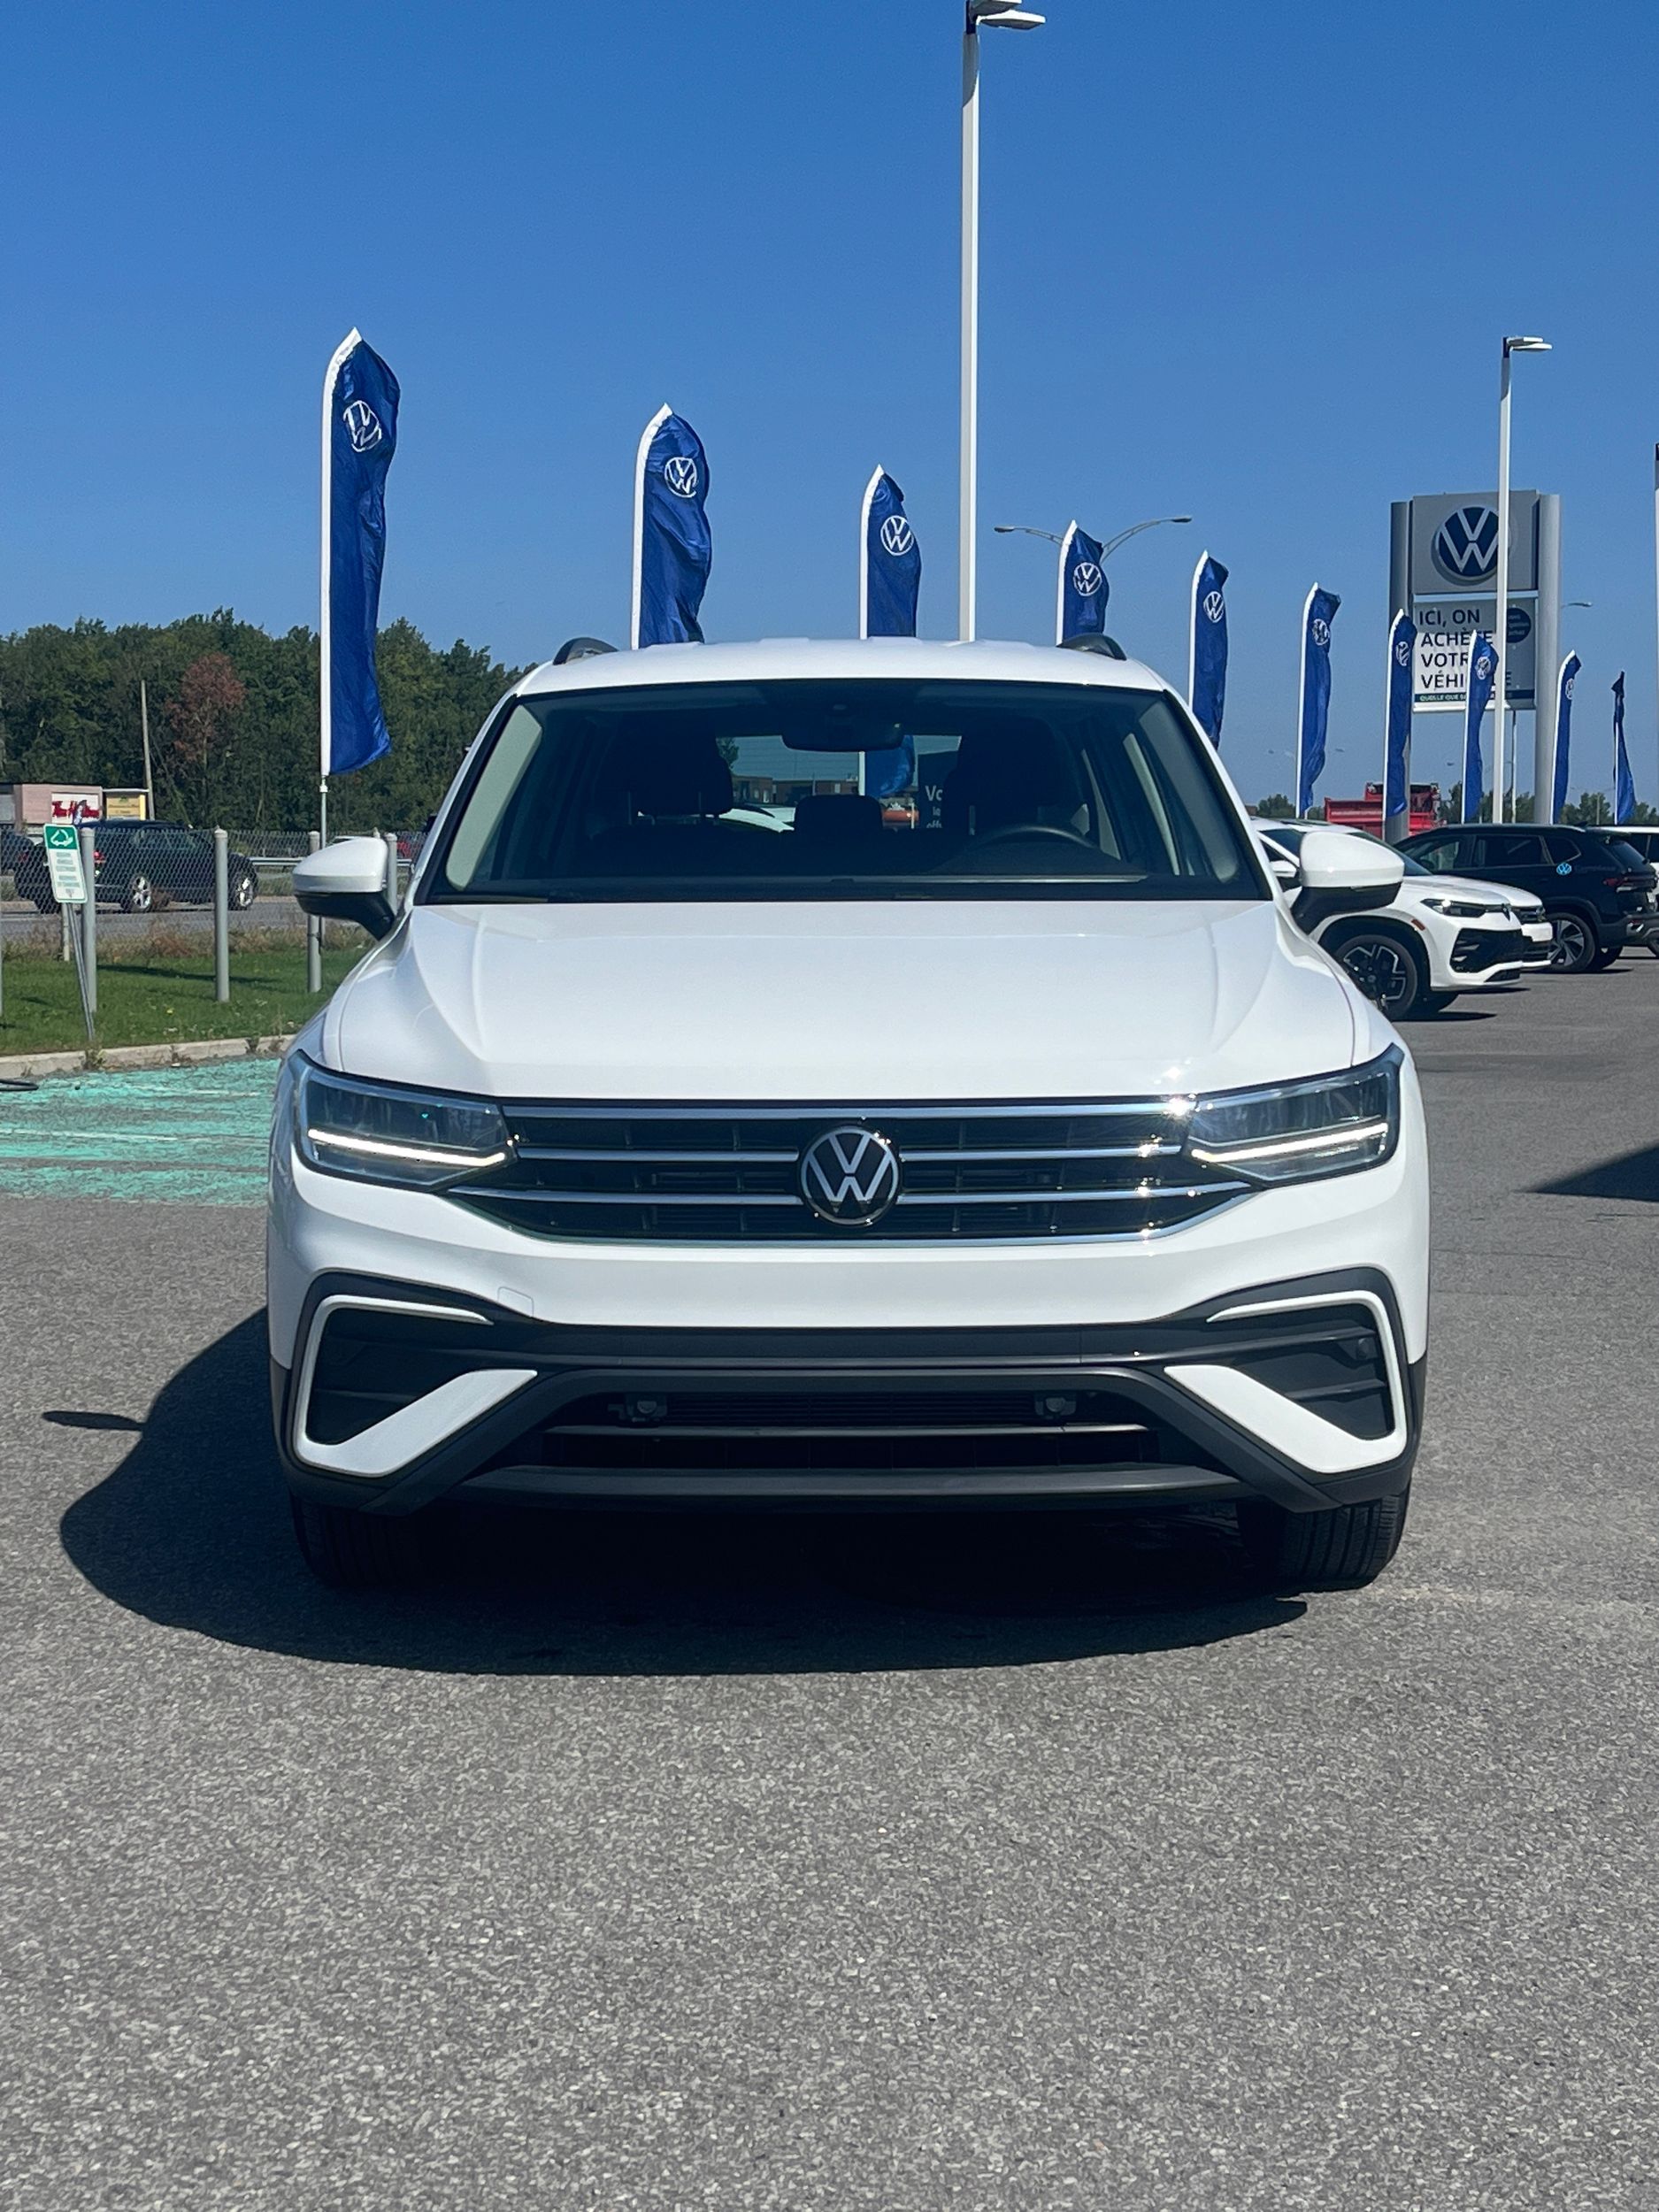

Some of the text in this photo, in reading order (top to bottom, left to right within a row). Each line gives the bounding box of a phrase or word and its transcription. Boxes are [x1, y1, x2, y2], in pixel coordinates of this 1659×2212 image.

[884, 517, 911, 550] VW
[1440, 508, 1499, 572] VW
[1419, 609, 1480, 627] ICI, ON
[1421, 627, 1494, 647] ACHÈE
[1421, 652, 1469, 668] VOTR
[806, 1133, 892, 1213] VW
